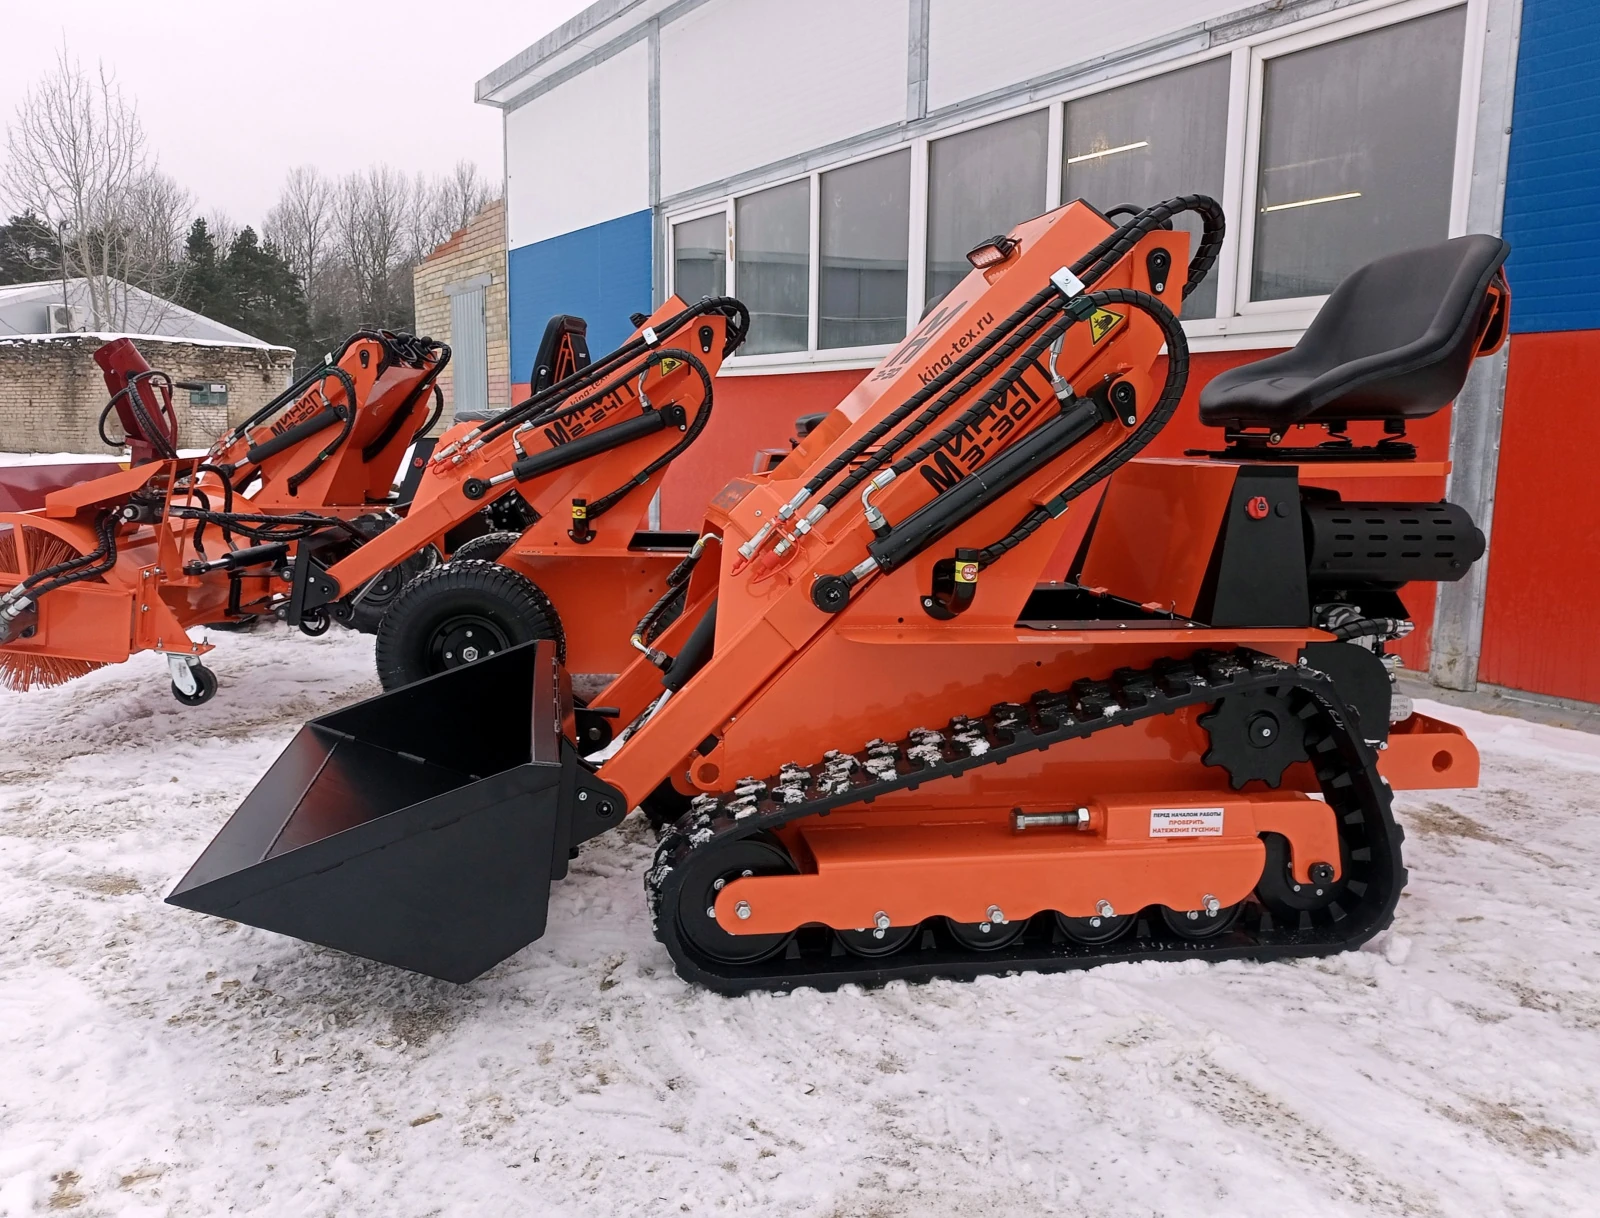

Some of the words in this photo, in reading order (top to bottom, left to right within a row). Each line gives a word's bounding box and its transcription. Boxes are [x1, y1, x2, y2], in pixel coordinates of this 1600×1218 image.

[917, 312, 995, 385] king-tex.ru
[569, 399, 618, 437] 2-24
[960, 397, 1031, 471] 3-30
